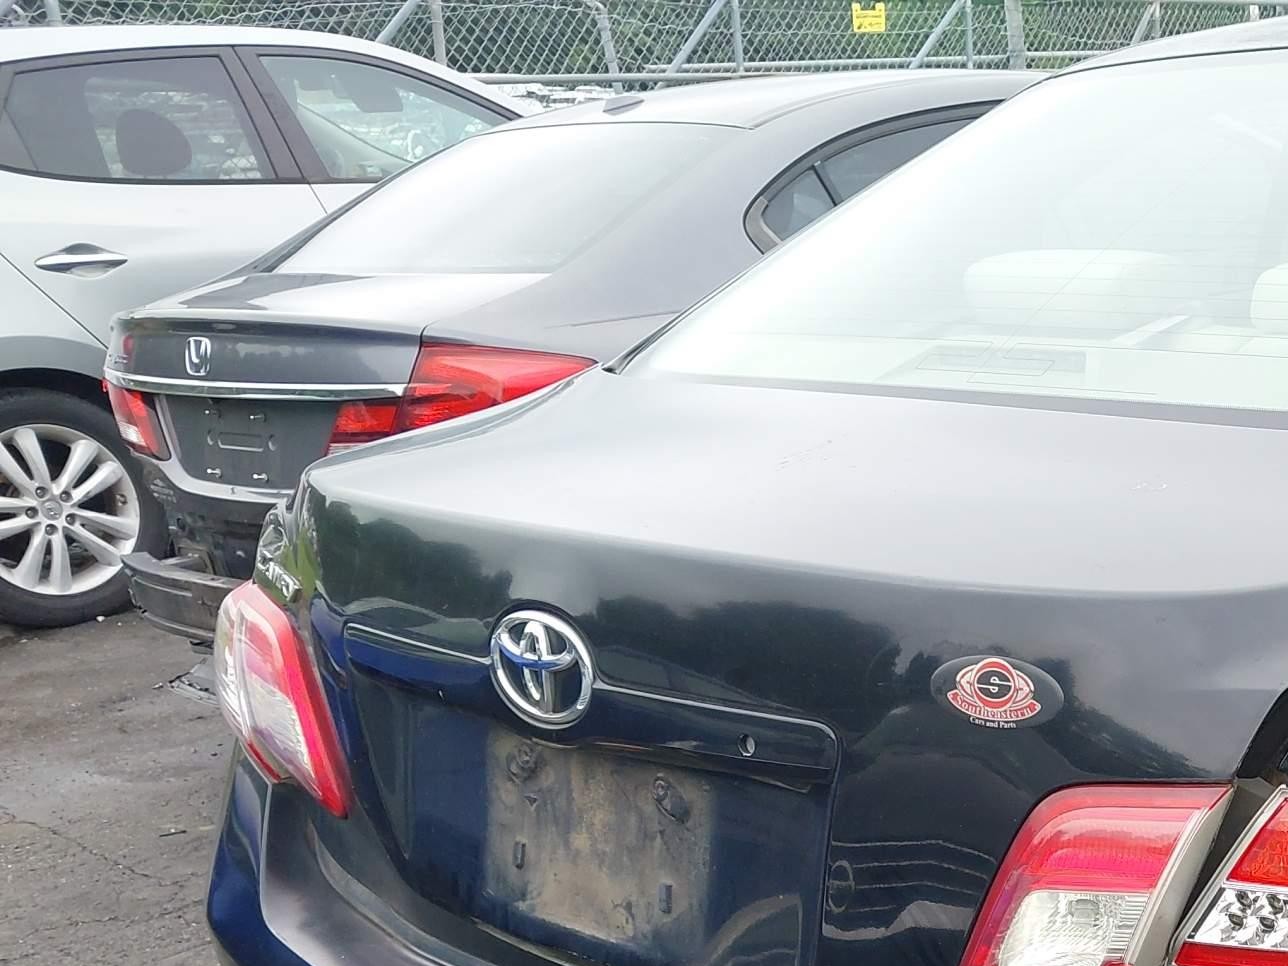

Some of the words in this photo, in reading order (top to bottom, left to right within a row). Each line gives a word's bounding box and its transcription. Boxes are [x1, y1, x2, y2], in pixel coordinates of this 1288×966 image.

[956, 695, 1031, 719] Southeastern
[969, 716, 985, 726] Cars
[1000, 721, 1016, 729] Parts
